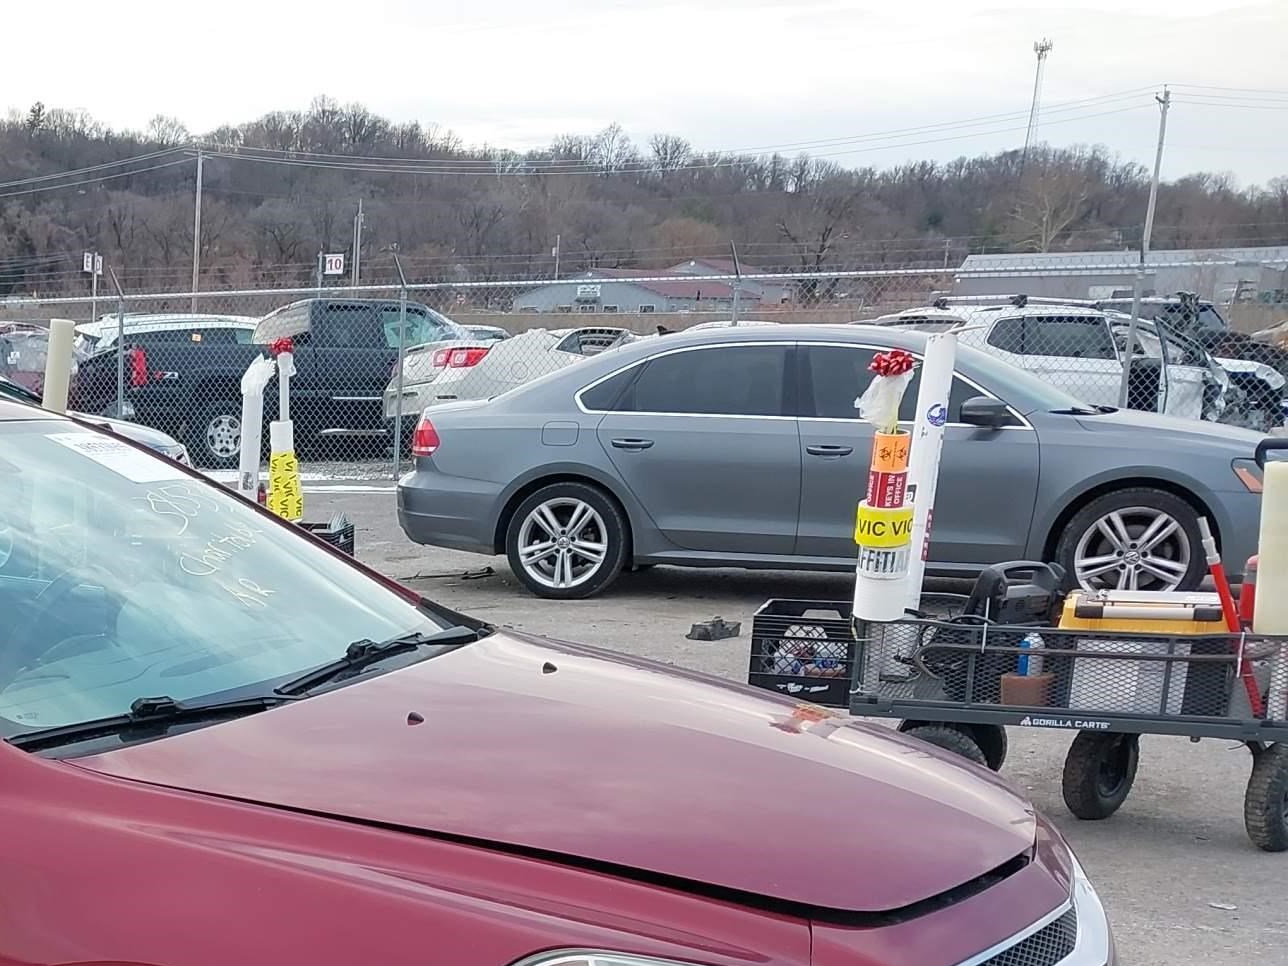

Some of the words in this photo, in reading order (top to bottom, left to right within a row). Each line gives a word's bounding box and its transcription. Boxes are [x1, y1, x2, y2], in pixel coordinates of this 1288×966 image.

[327, 258, 342, 271] 10
[888, 475, 896, 484] IN
[884, 484, 894, 507] KEYS
[893, 476, 904, 505] OFFICE
[280, 498, 289, 519] VIC
[859, 518, 886, 537] VIC
[1032, 718, 1072, 727] GORILLA
[1074, 720, 1110, 729] CARTS
